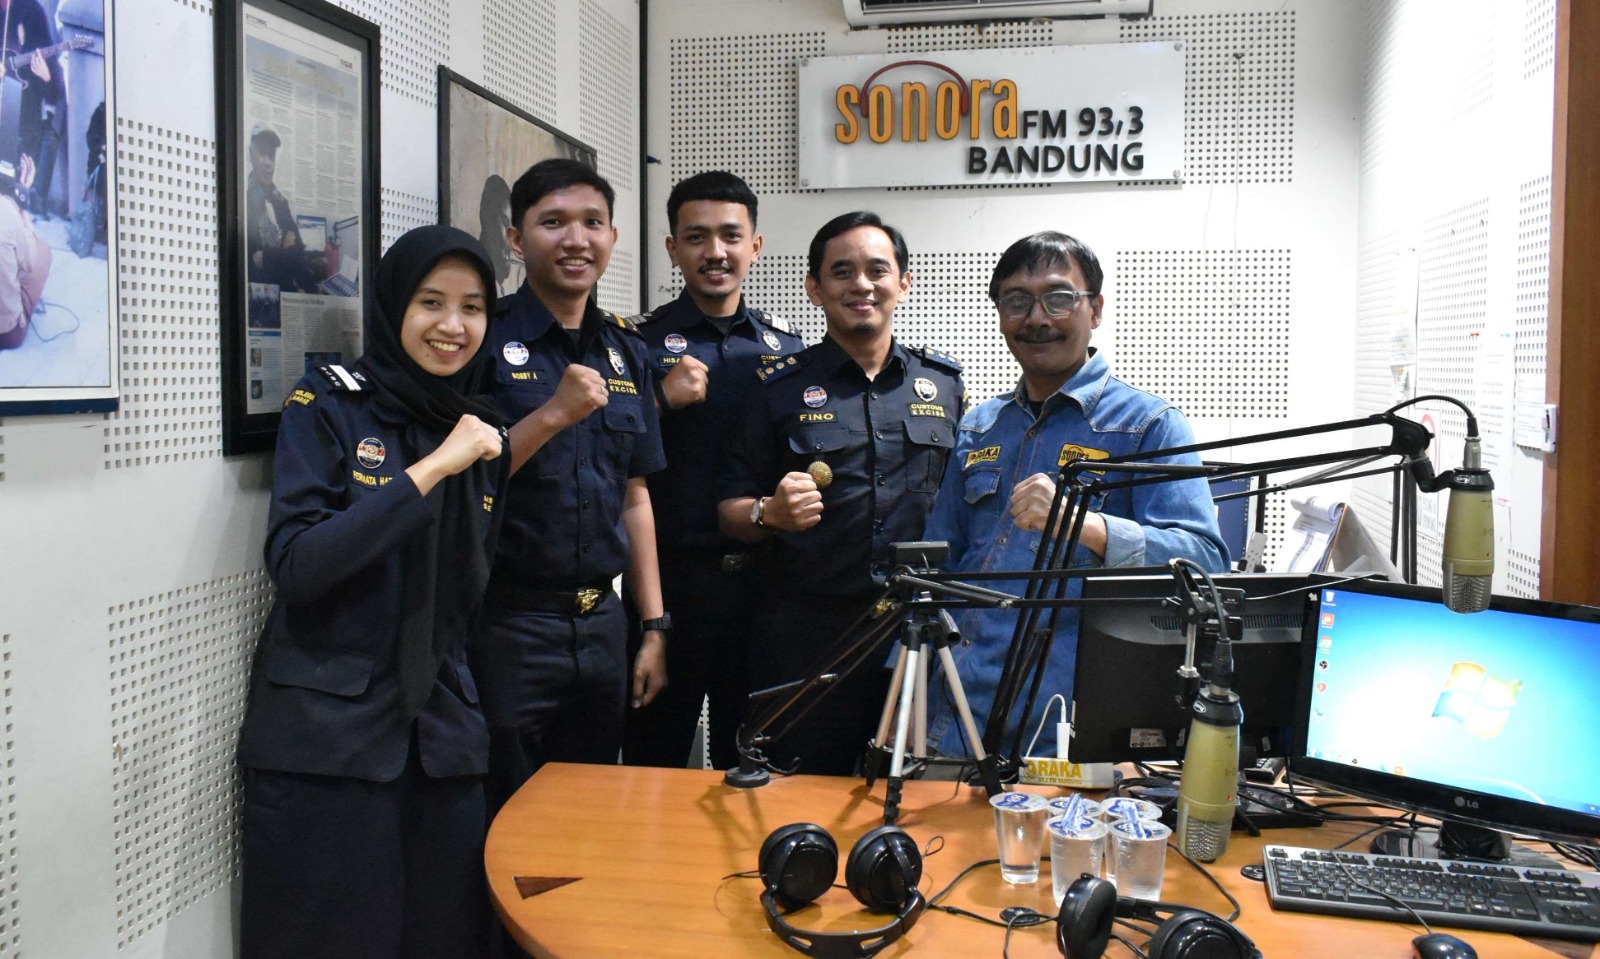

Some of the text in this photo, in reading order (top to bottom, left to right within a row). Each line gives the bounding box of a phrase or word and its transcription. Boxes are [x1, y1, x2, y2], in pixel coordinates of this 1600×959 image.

[835, 78, 1144, 144] sonora FM 93,3
[968, 142, 1144, 175] BANDUNG
[609, 385, 638, 395] EXCISE
[911, 403, 944, 411] CUSTOMS
[799, 413, 834, 422] FINO
[912, 409, 946, 418] EXCISE
[976, 447, 999, 461] RAKA
[352, 470, 377, 486] PERMATA
[1038, 760, 1082, 778] RAKA
[1466, 800, 1479, 809] LG
